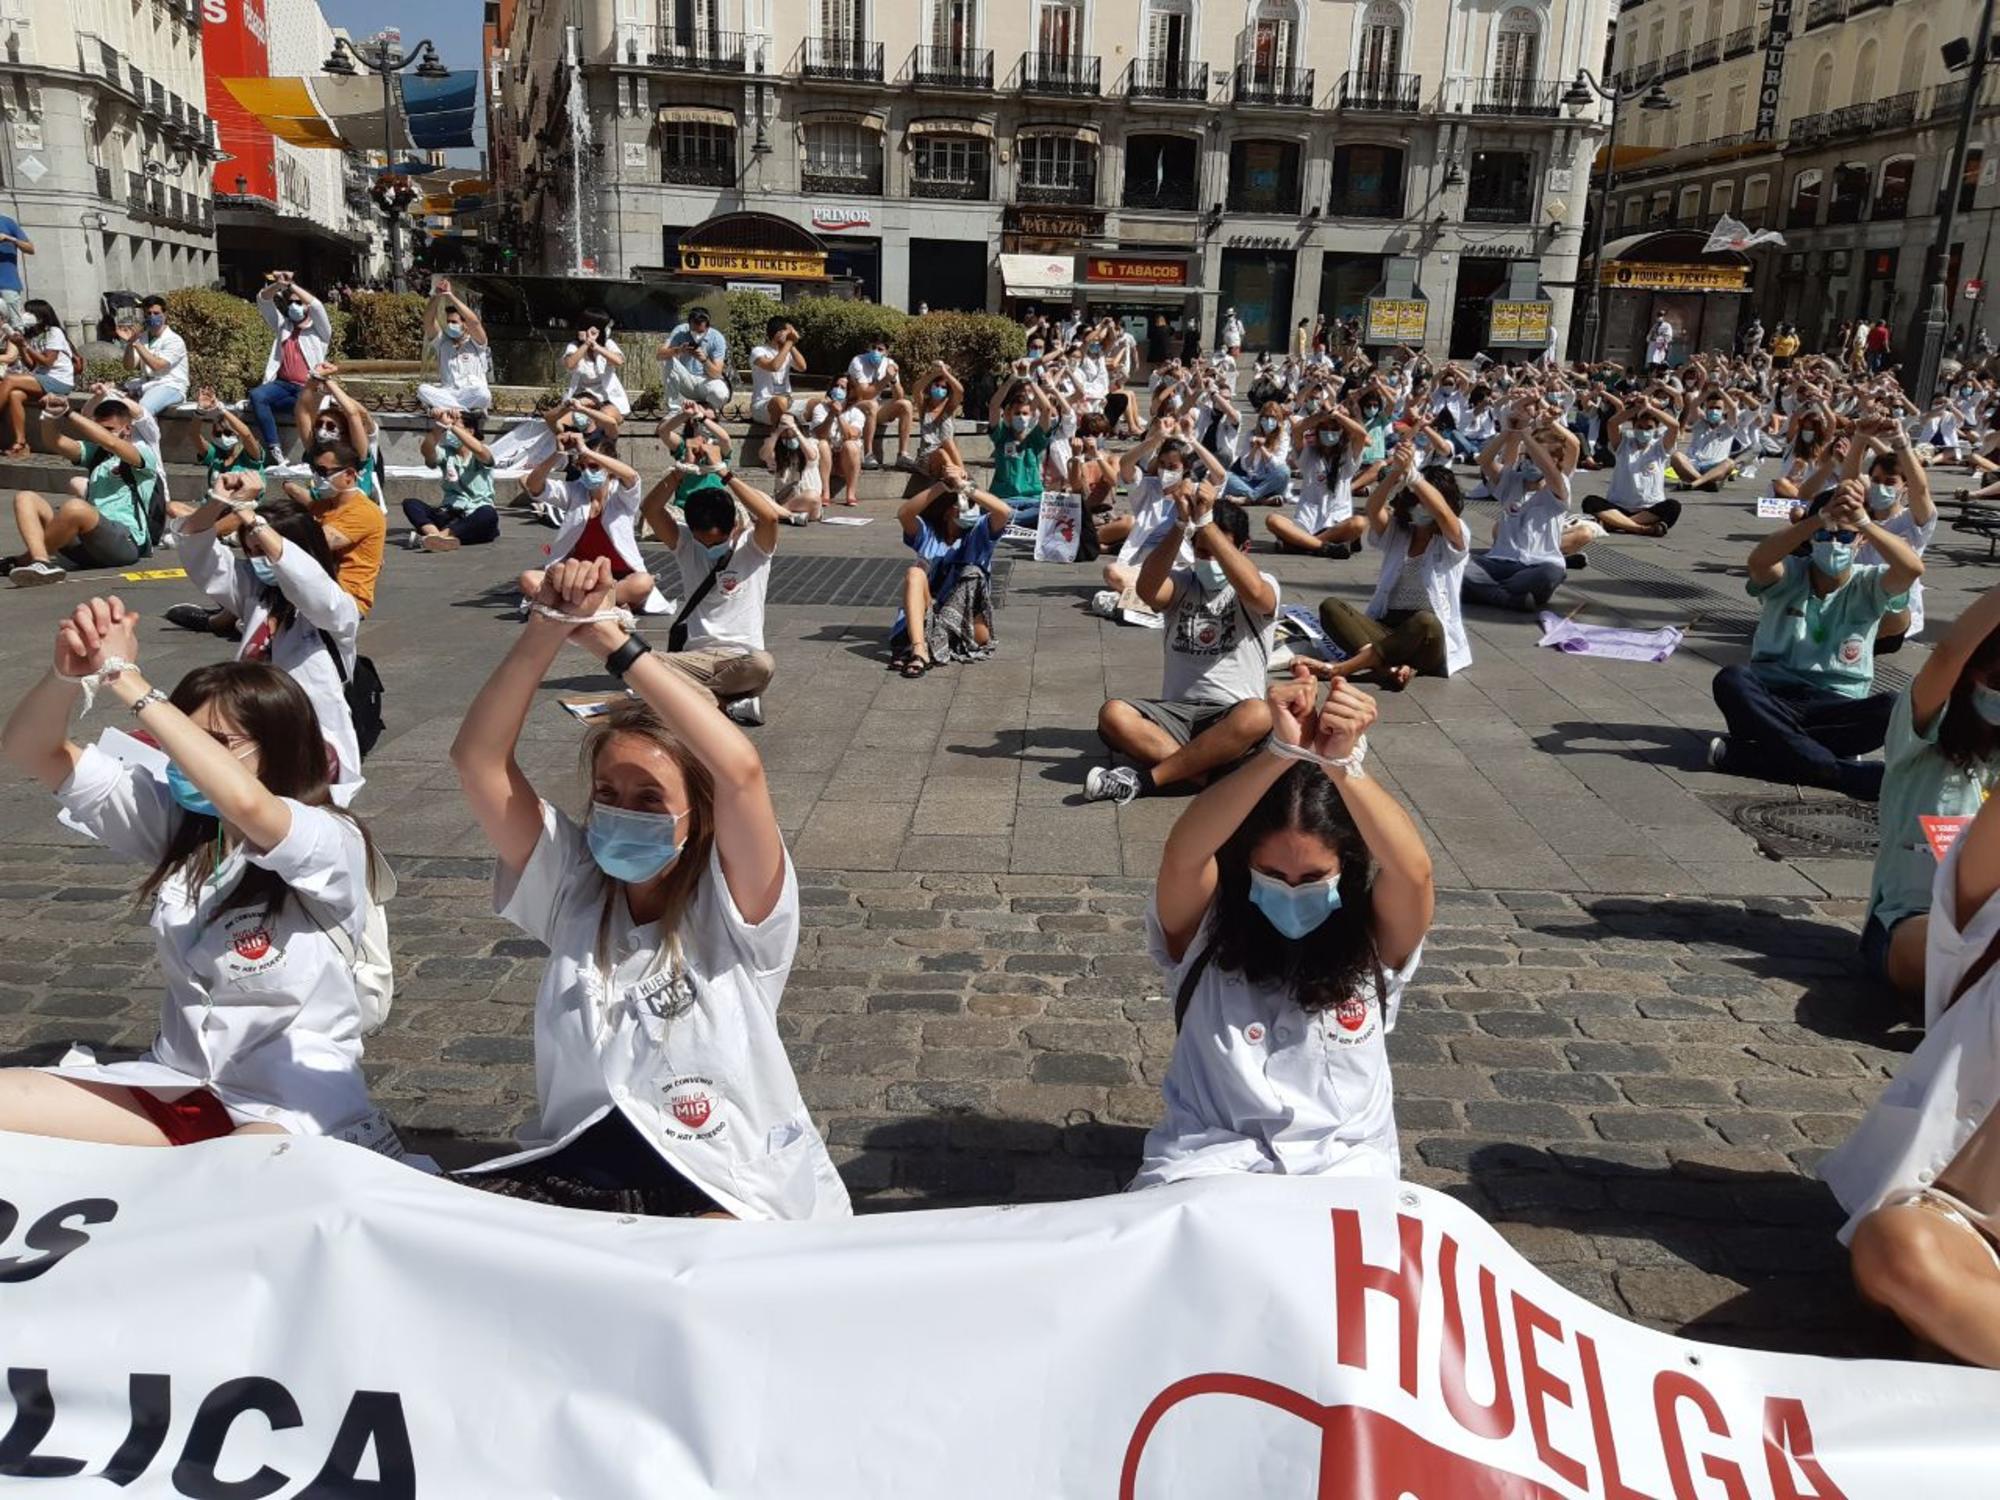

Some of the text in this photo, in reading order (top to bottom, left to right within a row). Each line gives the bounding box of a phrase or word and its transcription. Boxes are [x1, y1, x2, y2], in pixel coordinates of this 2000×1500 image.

[1759, 32, 1786, 141] EUROPA
[812, 207, 870, 222] PRIMOR
[1022, 214, 1087, 234] PALAZZO
[704, 255, 737, 268] TOURS
[741, 259, 749, 269] &
[754, 258, 798, 271] TICKETS
[1119, 265, 1179, 278] TABACOS
[1635, 271, 1665, 282] TOURS
[1679, 272, 1720, 284] TICKETS
[236, 934, 267, 951] MIR
[651, 979, 693, 1013] MIR
[1339, 1003, 1364, 1018] MIR
[672, 1092, 706, 1103] HUELGA
[676, 1102, 707, 1117] MIR
[665, 1128, 676, 1137] NO
[677, 1133, 693, 1141] HAY
[0, 1198, 118, 1283] S
[1331, 1208, 1844, 1500] HUELGA
